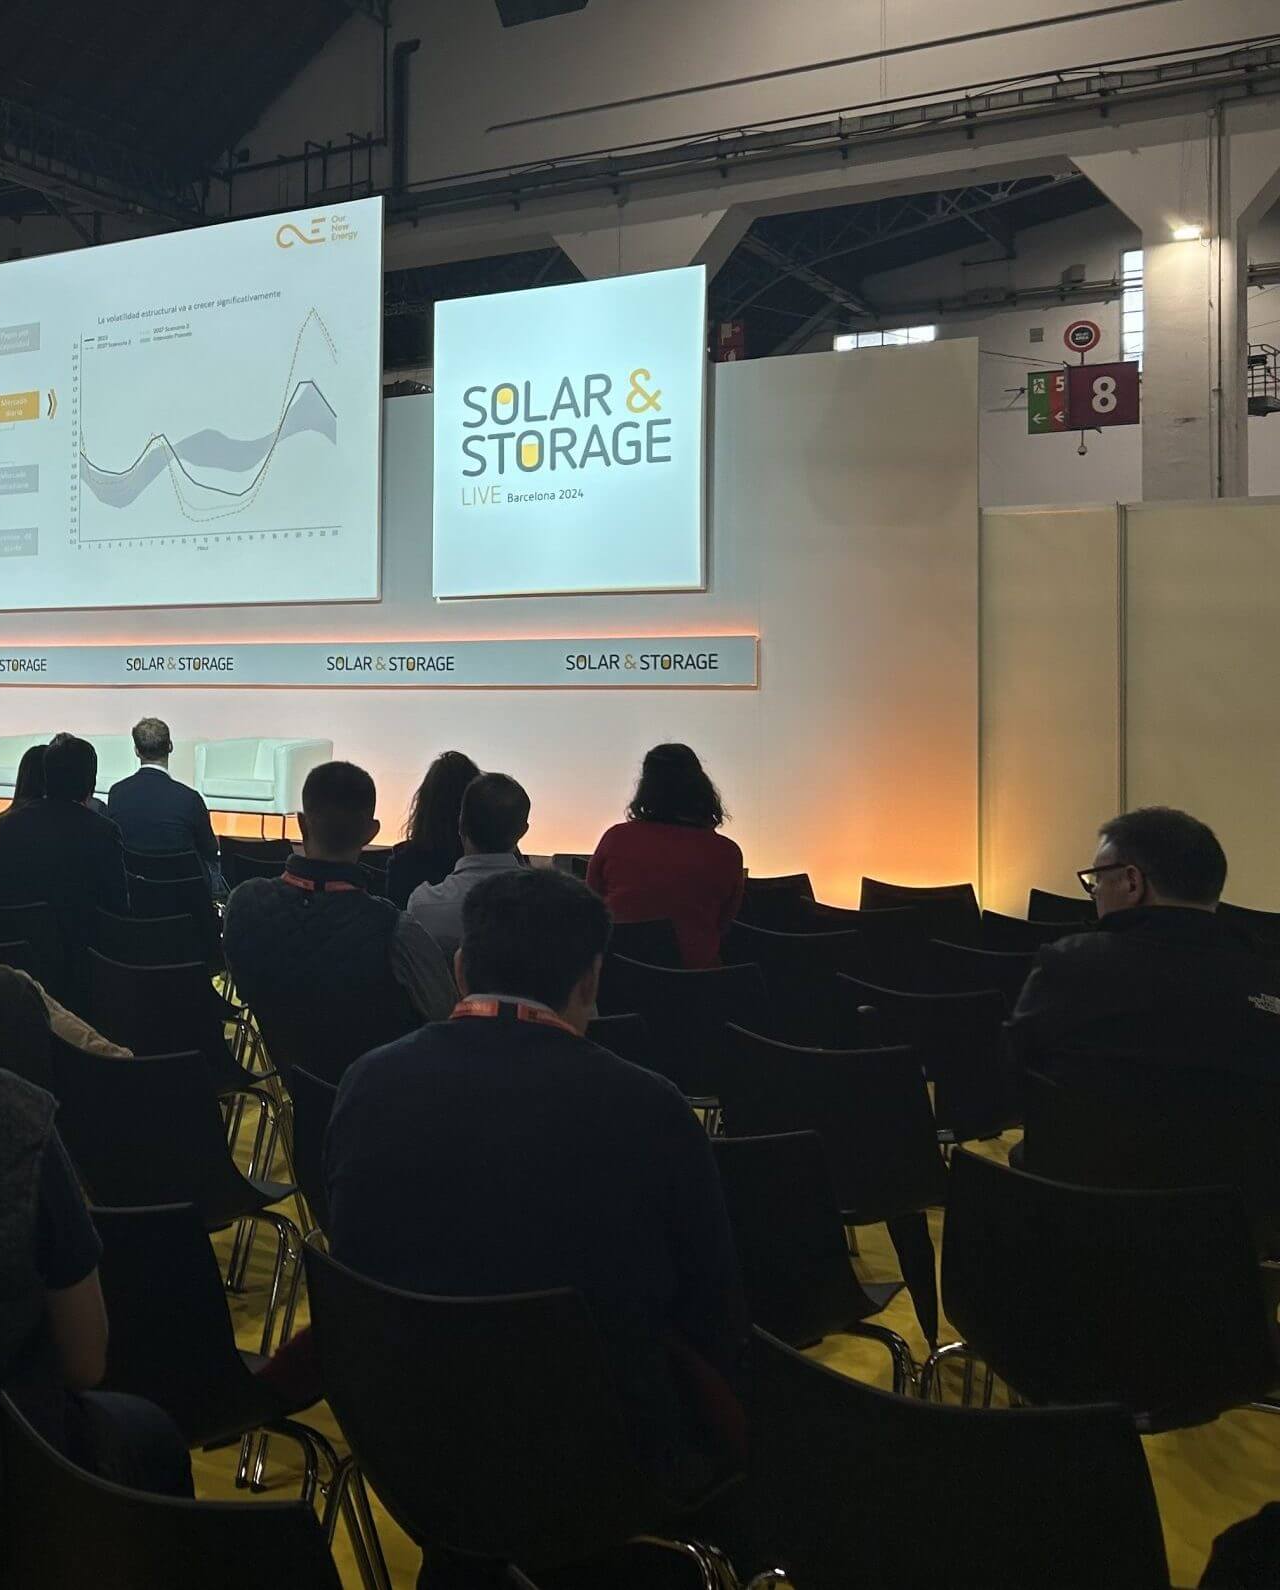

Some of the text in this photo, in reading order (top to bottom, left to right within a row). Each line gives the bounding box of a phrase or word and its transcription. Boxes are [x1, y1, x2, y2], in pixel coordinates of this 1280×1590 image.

[332, 224, 349, 232] New
[332, 231, 358, 241] Energy
[106, 311, 140, 324] volatilidad
[141, 305, 177, 318] estructural
[178, 304, 187, 312] va
[194, 300, 215, 310] crecer
[216, 290, 281, 307] significativamente
[462, 367, 662, 428] SOLAR &
[1091, 376, 1118, 414] 8
[462, 418, 672, 478] STORAGE
[462, 485, 584, 506] LIVE Barcelona 2024
[0, 658, 47, 672] STORAGE
[126, 657, 234, 672] SOLAR & STORAGE
[326, 656, 455, 672] SOLAR & STORAGE
[566, 653, 718, 671] SOLAR & STORAGE
